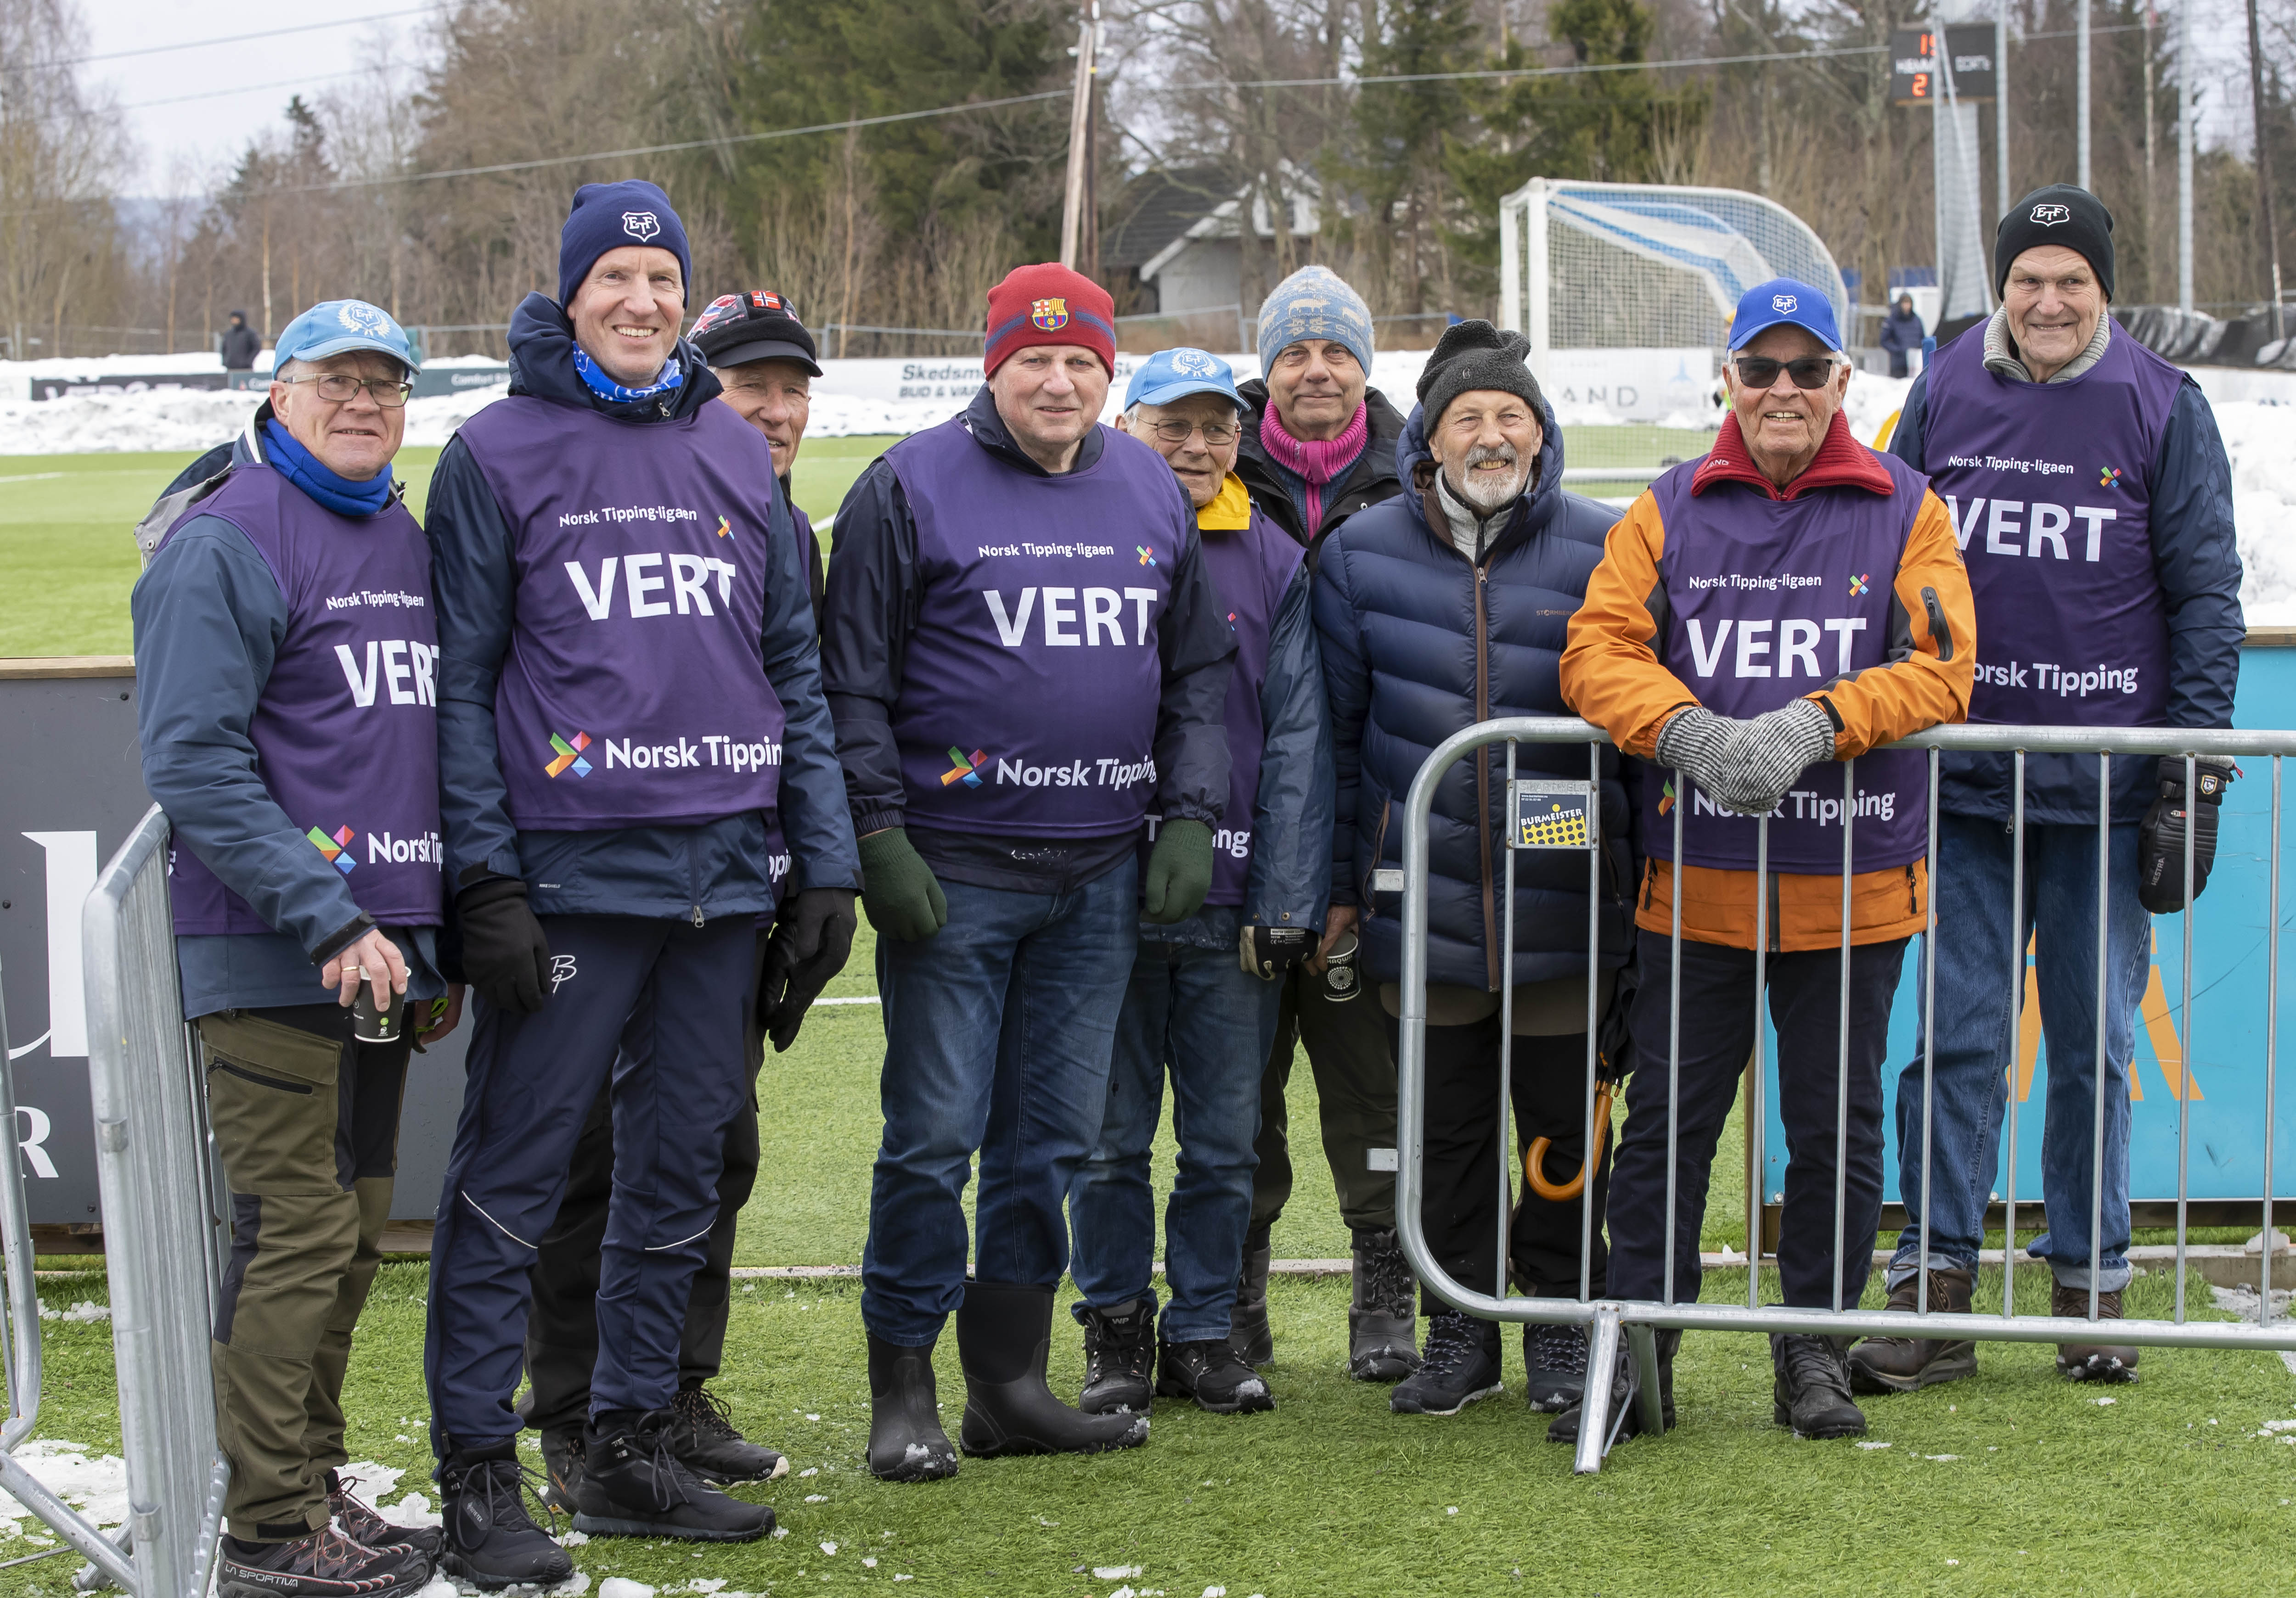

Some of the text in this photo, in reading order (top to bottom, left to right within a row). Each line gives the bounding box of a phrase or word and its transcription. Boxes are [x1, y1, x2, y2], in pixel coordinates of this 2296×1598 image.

[1912, 73, 1928, 96] 2
[903, 364, 986, 380] Skedsm
[1948, 455, 2074, 475] Norsk Tipping-ligaen
[559, 505, 697, 527] Norsk Tipping-ligaen
[1946, 494, 2117, 562] VERT
[979, 542, 1114, 558] Norsk Tipping-ligaen
[564, 552, 736, 621] VERT
[1689, 573, 1822, 591] Norsk Tipping-ligaen
[326, 589, 424, 611] Norsk Tipping-ligaen
[983, 587, 1157, 647] VERT
[1686, 617, 1867, 678] VERT
[1973, 661, 2138, 697] orsk Tipping
[605, 735, 782, 773] Norsk Tippin
[996, 758, 1091, 786] Norsk
[1520, 808, 1583, 826] BURMEISTER
[1790, 789, 1895, 826] Tipping
[367, 831, 431, 864] Norsk
[2151, 857, 2165, 886] HESTRA
[225, 1564, 298, 1587] LA SPORTIVA
